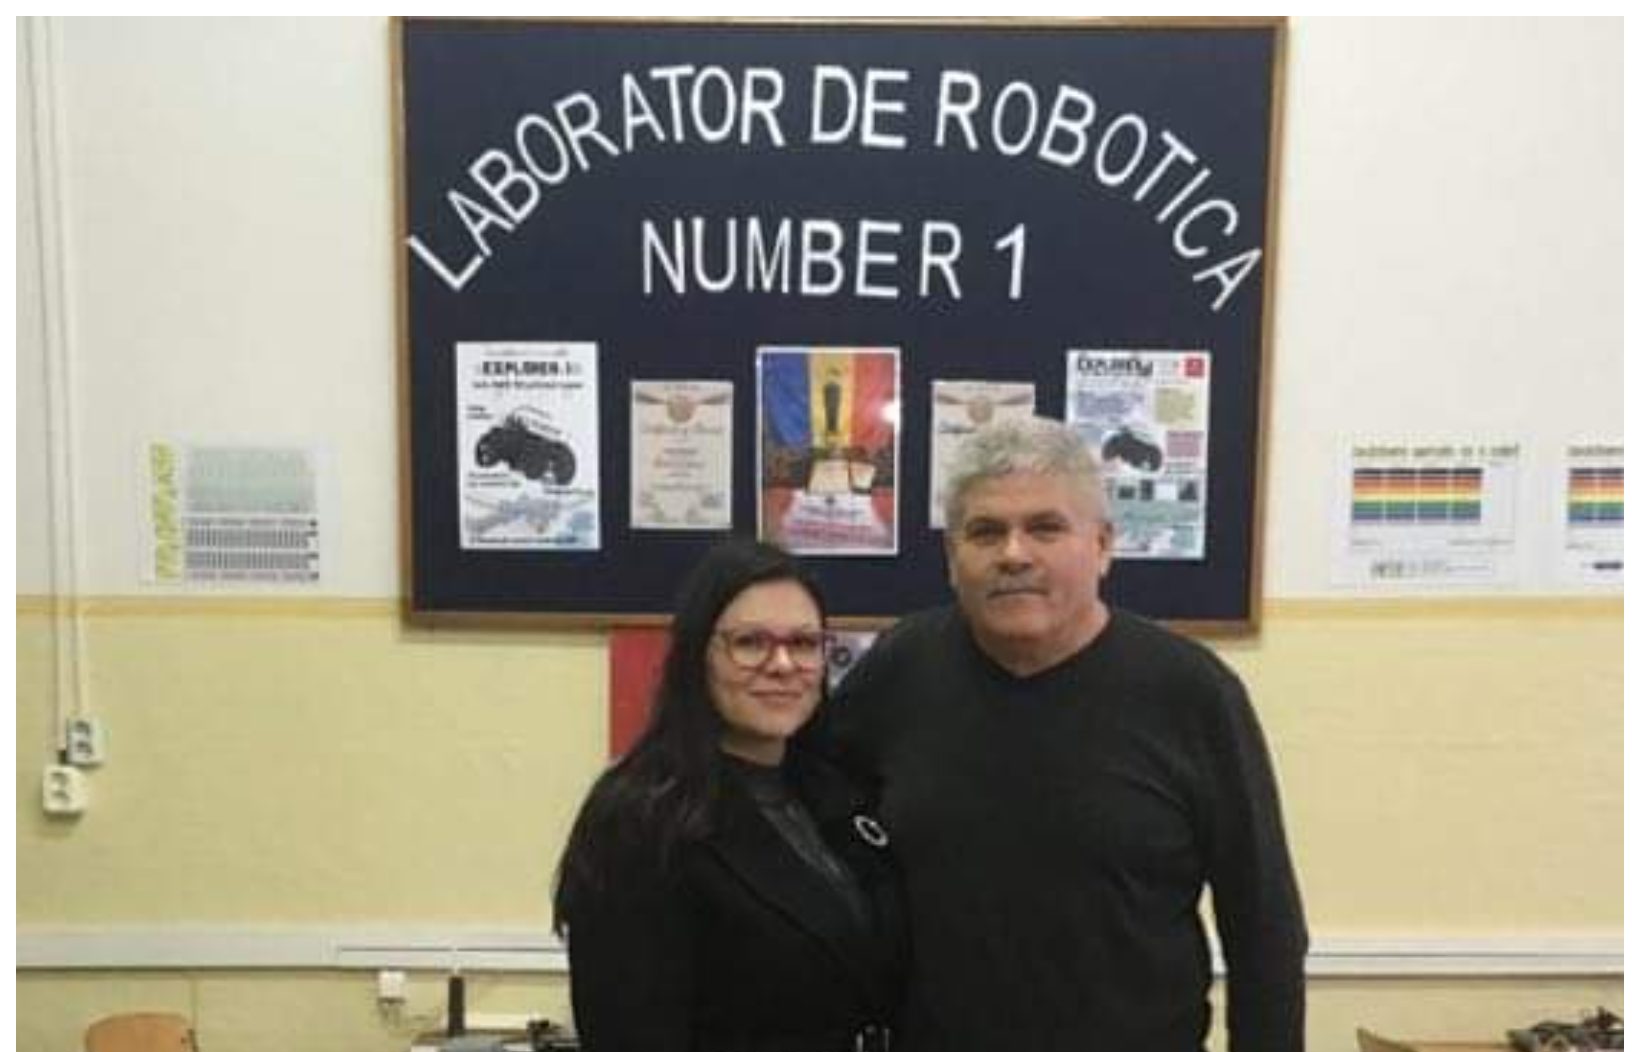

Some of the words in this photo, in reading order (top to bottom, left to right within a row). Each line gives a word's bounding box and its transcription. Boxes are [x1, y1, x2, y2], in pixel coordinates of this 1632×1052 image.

[402, 63, 786, 290] LABORATOR
[811, 64, 910, 149] DE
[936, 69, 1263, 311] ROBOTICA
[644, 216, 962, 299] NUMBER
[995, 223, 1025, 299] 1
